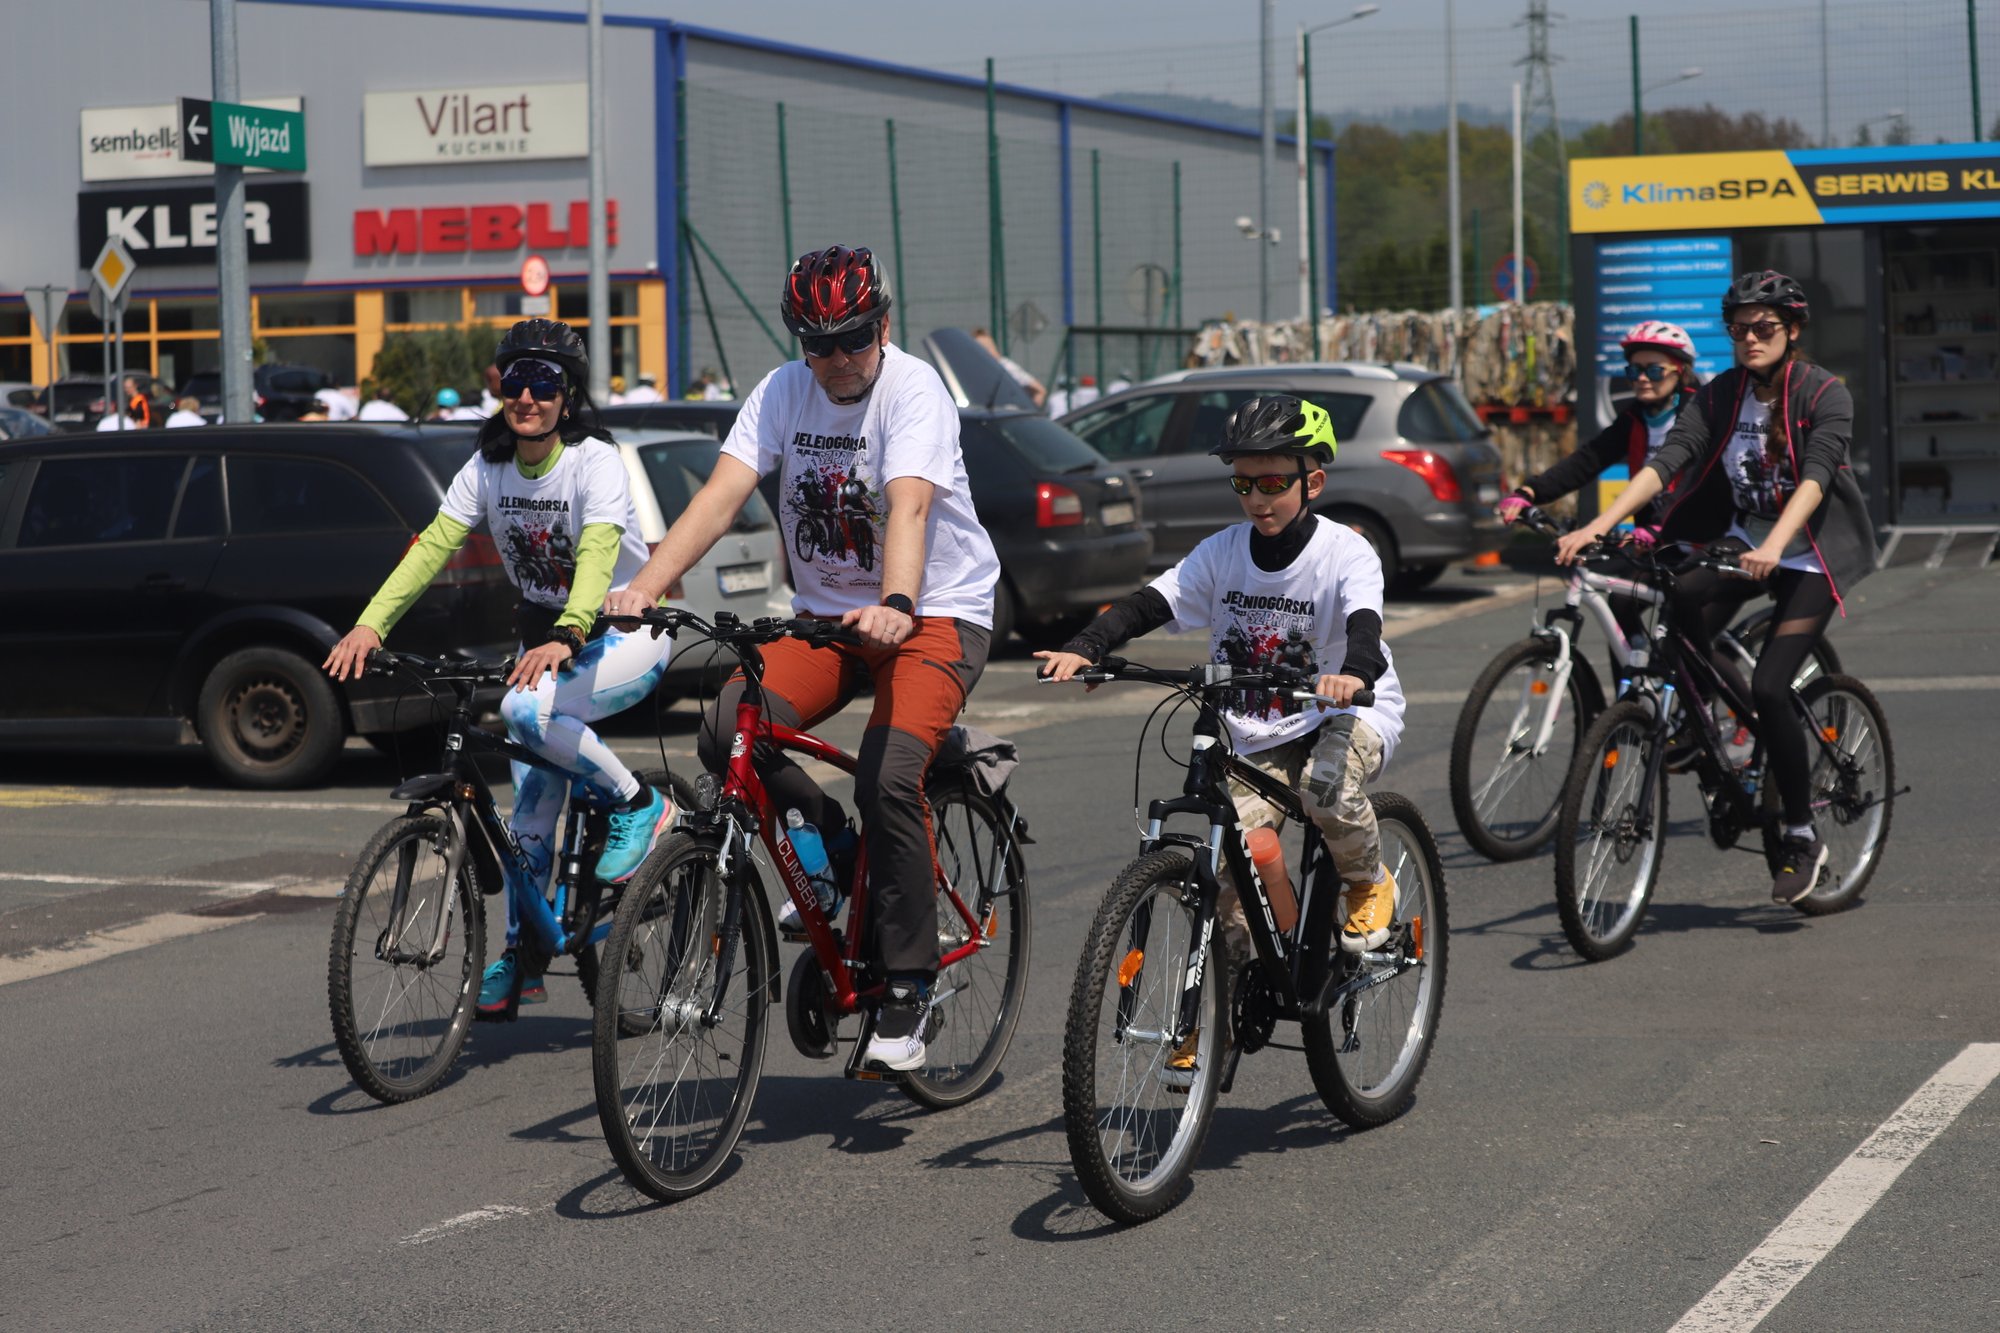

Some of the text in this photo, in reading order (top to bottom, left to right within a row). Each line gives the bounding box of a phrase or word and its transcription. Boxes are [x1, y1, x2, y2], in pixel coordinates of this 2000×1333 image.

[228, 114, 291, 157] Wyjazd
[417, 93, 532, 136] Vilart
[437, 139, 528, 155] KUCHNIE
[1622, 178, 1796, 204] KlimaSPA
[1815, 170, 1949, 196] SERWIS
[106, 201, 272, 249] KLER
[777, 837, 818, 912] CLIMBER
[1195, 919, 1210, 987] KROSS
